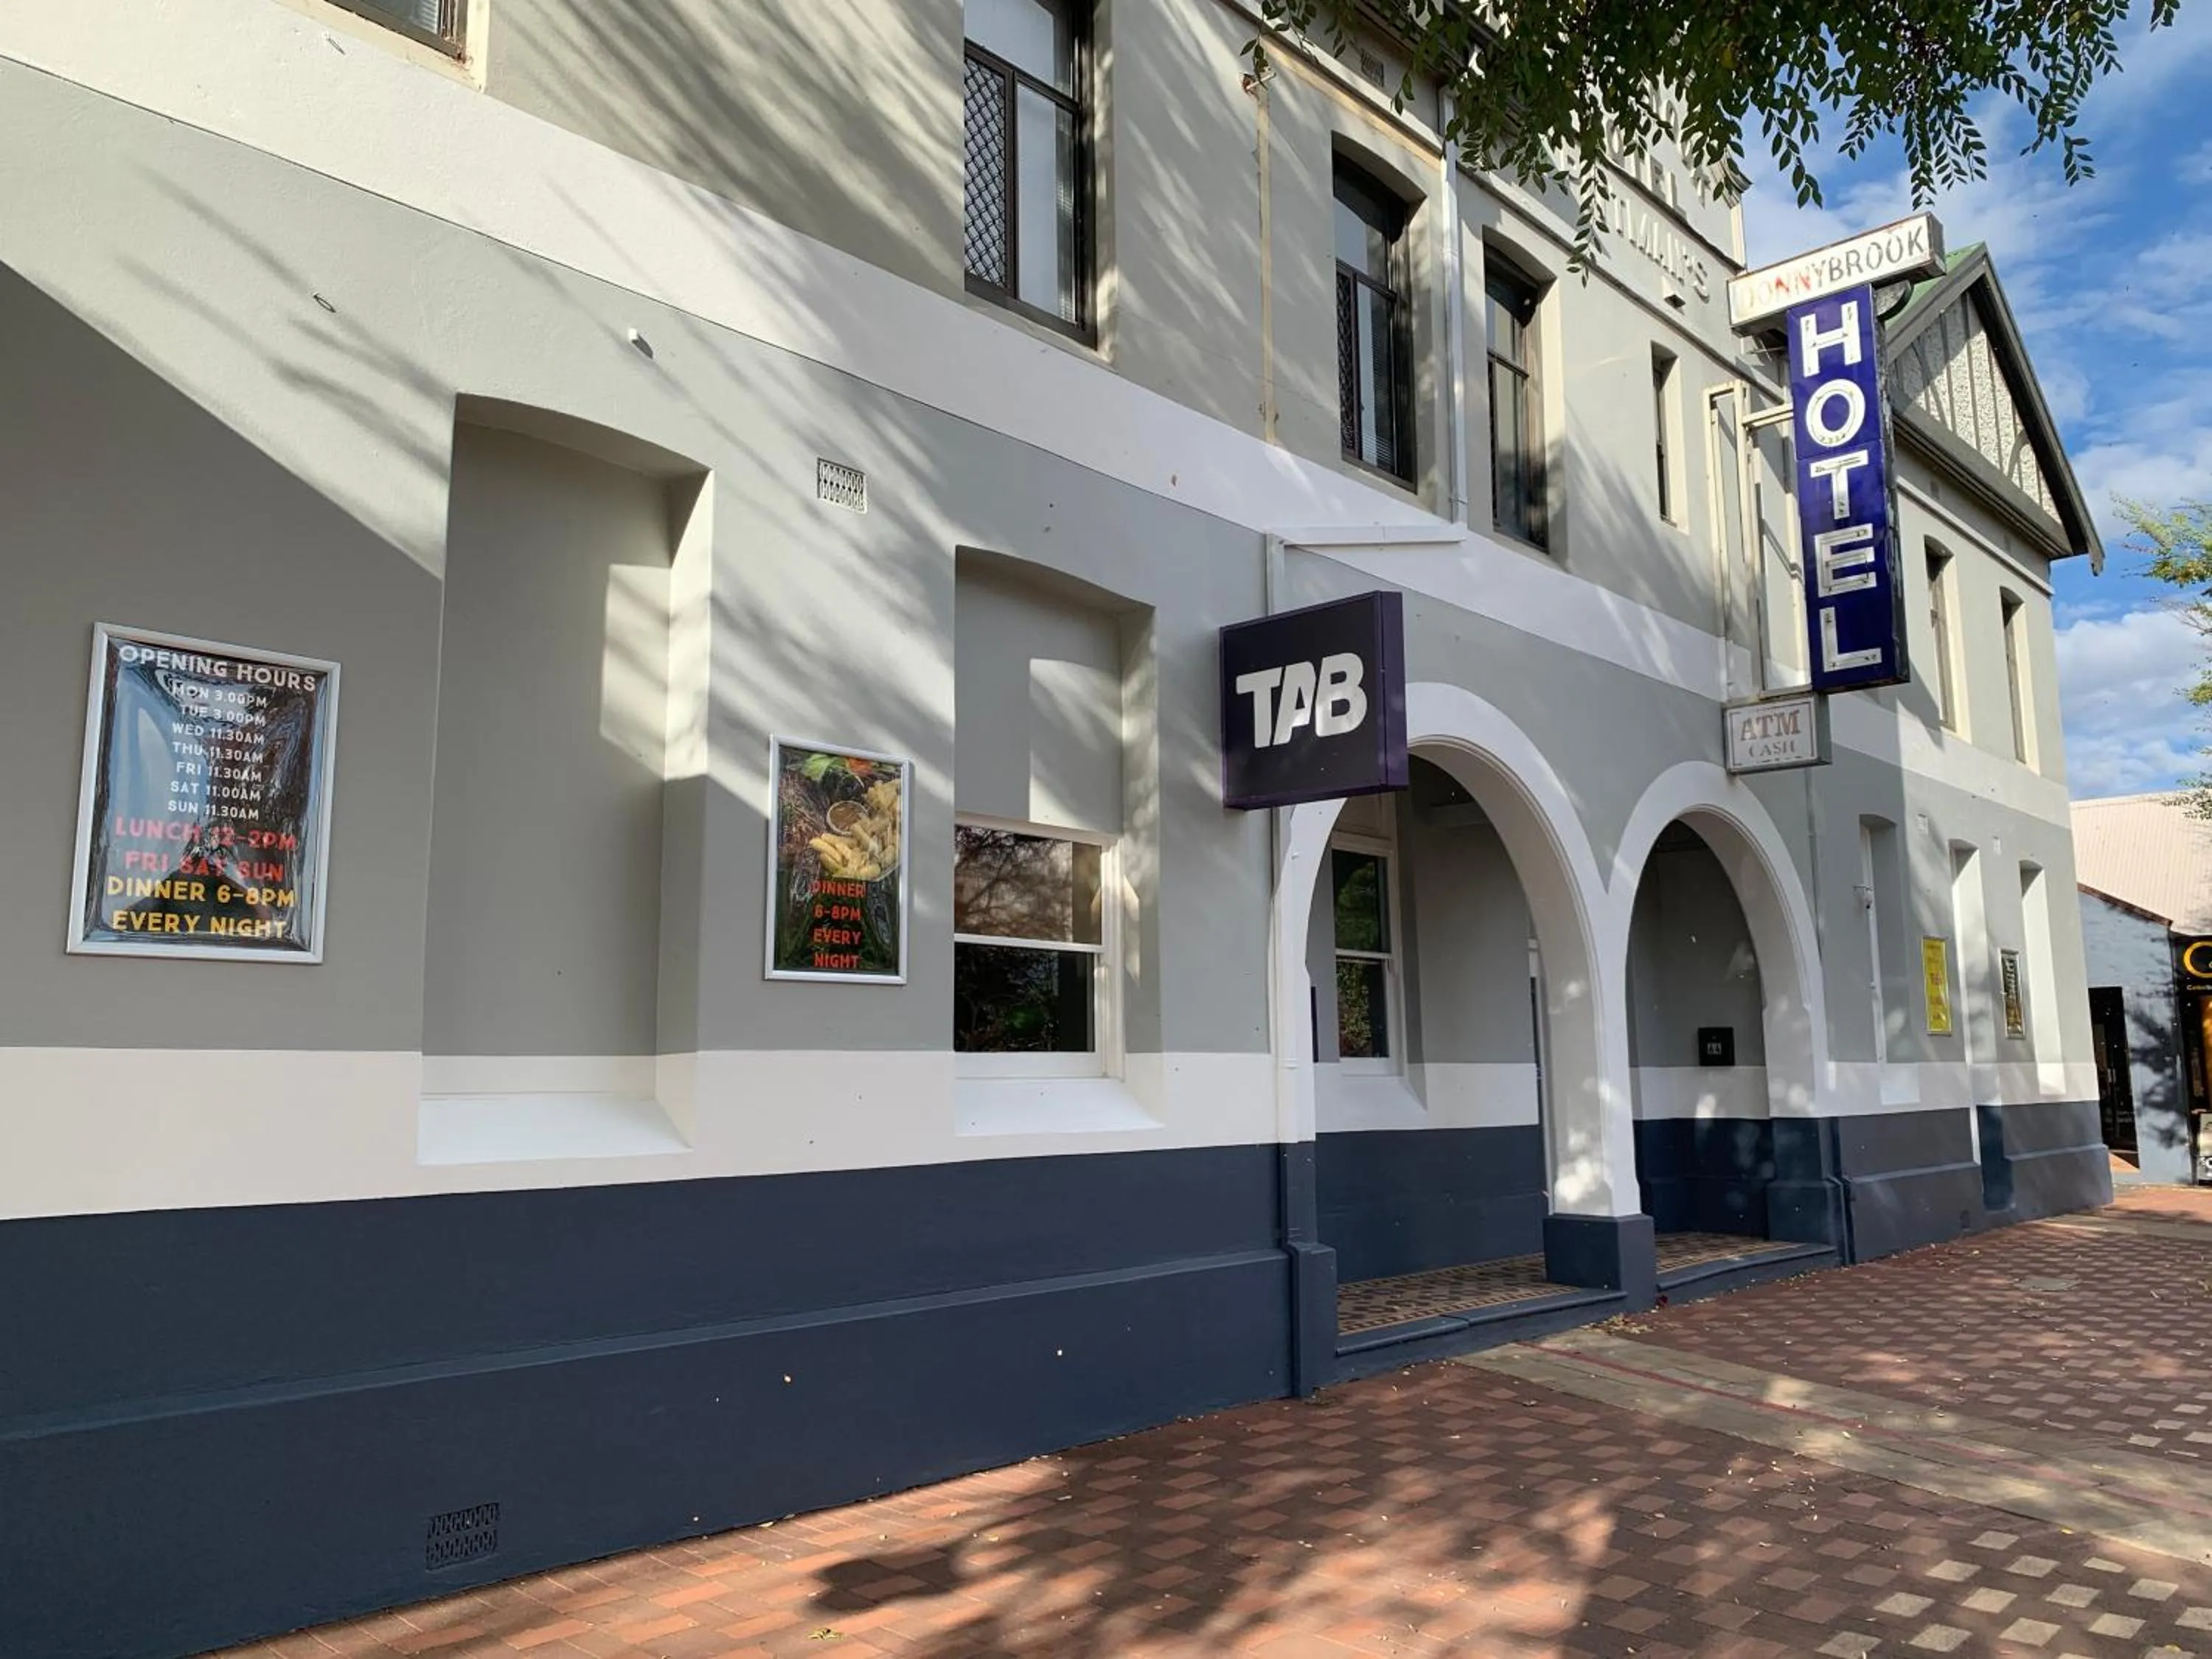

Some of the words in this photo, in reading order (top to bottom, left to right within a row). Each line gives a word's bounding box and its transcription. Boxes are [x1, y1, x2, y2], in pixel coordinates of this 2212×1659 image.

[1800, 300, 1882, 672] HOTEL
[119, 645, 229, 678] OPENING
[237, 667, 316, 692] HOURS
[173, 681, 209, 699] MON
[1235, 652, 1368, 749] TAB
[180, 704, 207, 717] TUE
[173, 723, 205, 737] WED
[209, 728, 264, 745] 11.30AM
[1740, 709, 1801, 741] ATM
[173, 742, 204, 757] THU
[209, 746, 263, 763] 11.30AM
[176, 762, 201, 775] FRI
[208, 765, 262, 782] 11.30AM
[170, 781, 199, 794] SAT
[168, 800, 198, 813] SUN
[205, 803, 259, 820] 11.30AM
[115, 816, 201, 844] LUNCH
[125, 851, 169, 872] FRI
[180, 855, 228, 877] SAT
[237, 860, 283, 882] SUN
[107, 876, 206, 902] DINNER
[217, 885, 295, 908] 6-8PM
[811, 879, 866, 898] DINNER
[112, 910, 201, 933] EVERY
[210, 916, 287, 939] NIGHT
[813, 928, 862, 945] EVERY
[813, 954, 860, 969] NIGHT
